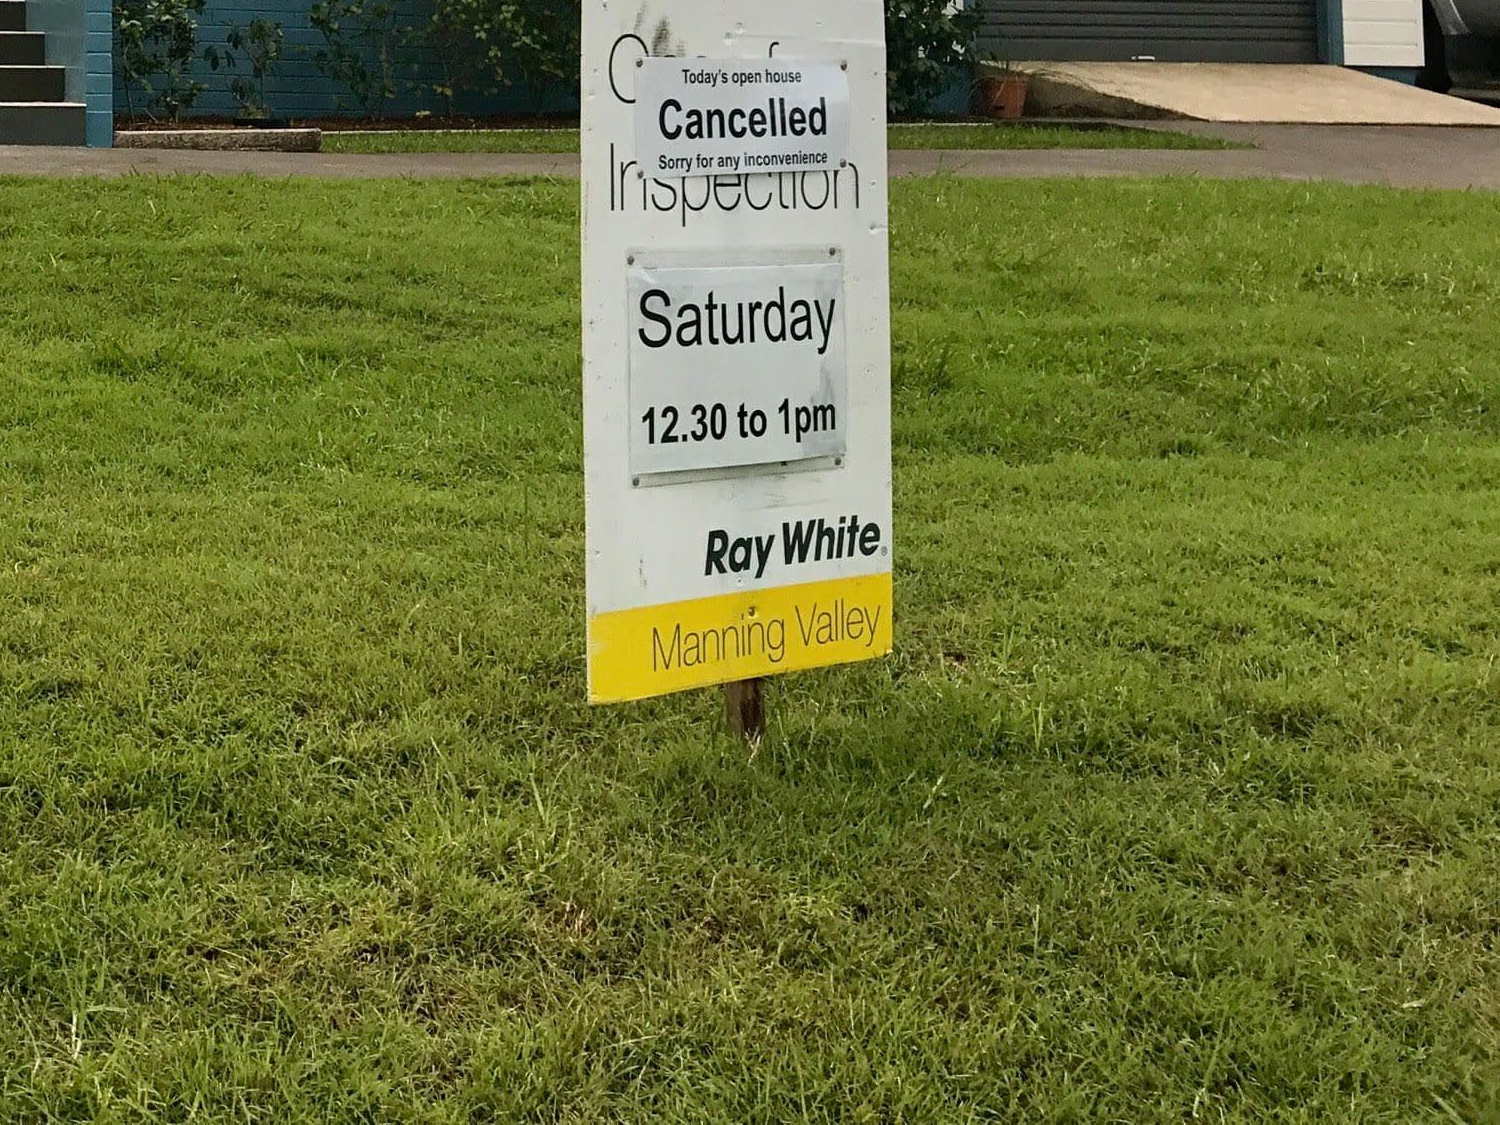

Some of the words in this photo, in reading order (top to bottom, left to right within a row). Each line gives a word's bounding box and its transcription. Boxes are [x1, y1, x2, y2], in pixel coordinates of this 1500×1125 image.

[731, 72, 762, 87] open
[765, 69, 802, 83] house
[658, 97, 827, 140] Cancelled
[658, 154, 693, 173] Sorry
[696, 153, 714, 168] for
[717, 153, 741, 171] any
[743, 150, 828, 167] inconvenience
[637, 286, 837, 355] Saturday
[641, 402, 728, 444] 12.30
[736, 402, 768, 439] to
[777, 397, 837, 442] 1pm
[704, 529, 775, 578] Ray
[651, 613, 787, 672] Manning
[794, 599, 882, 647] Valley
